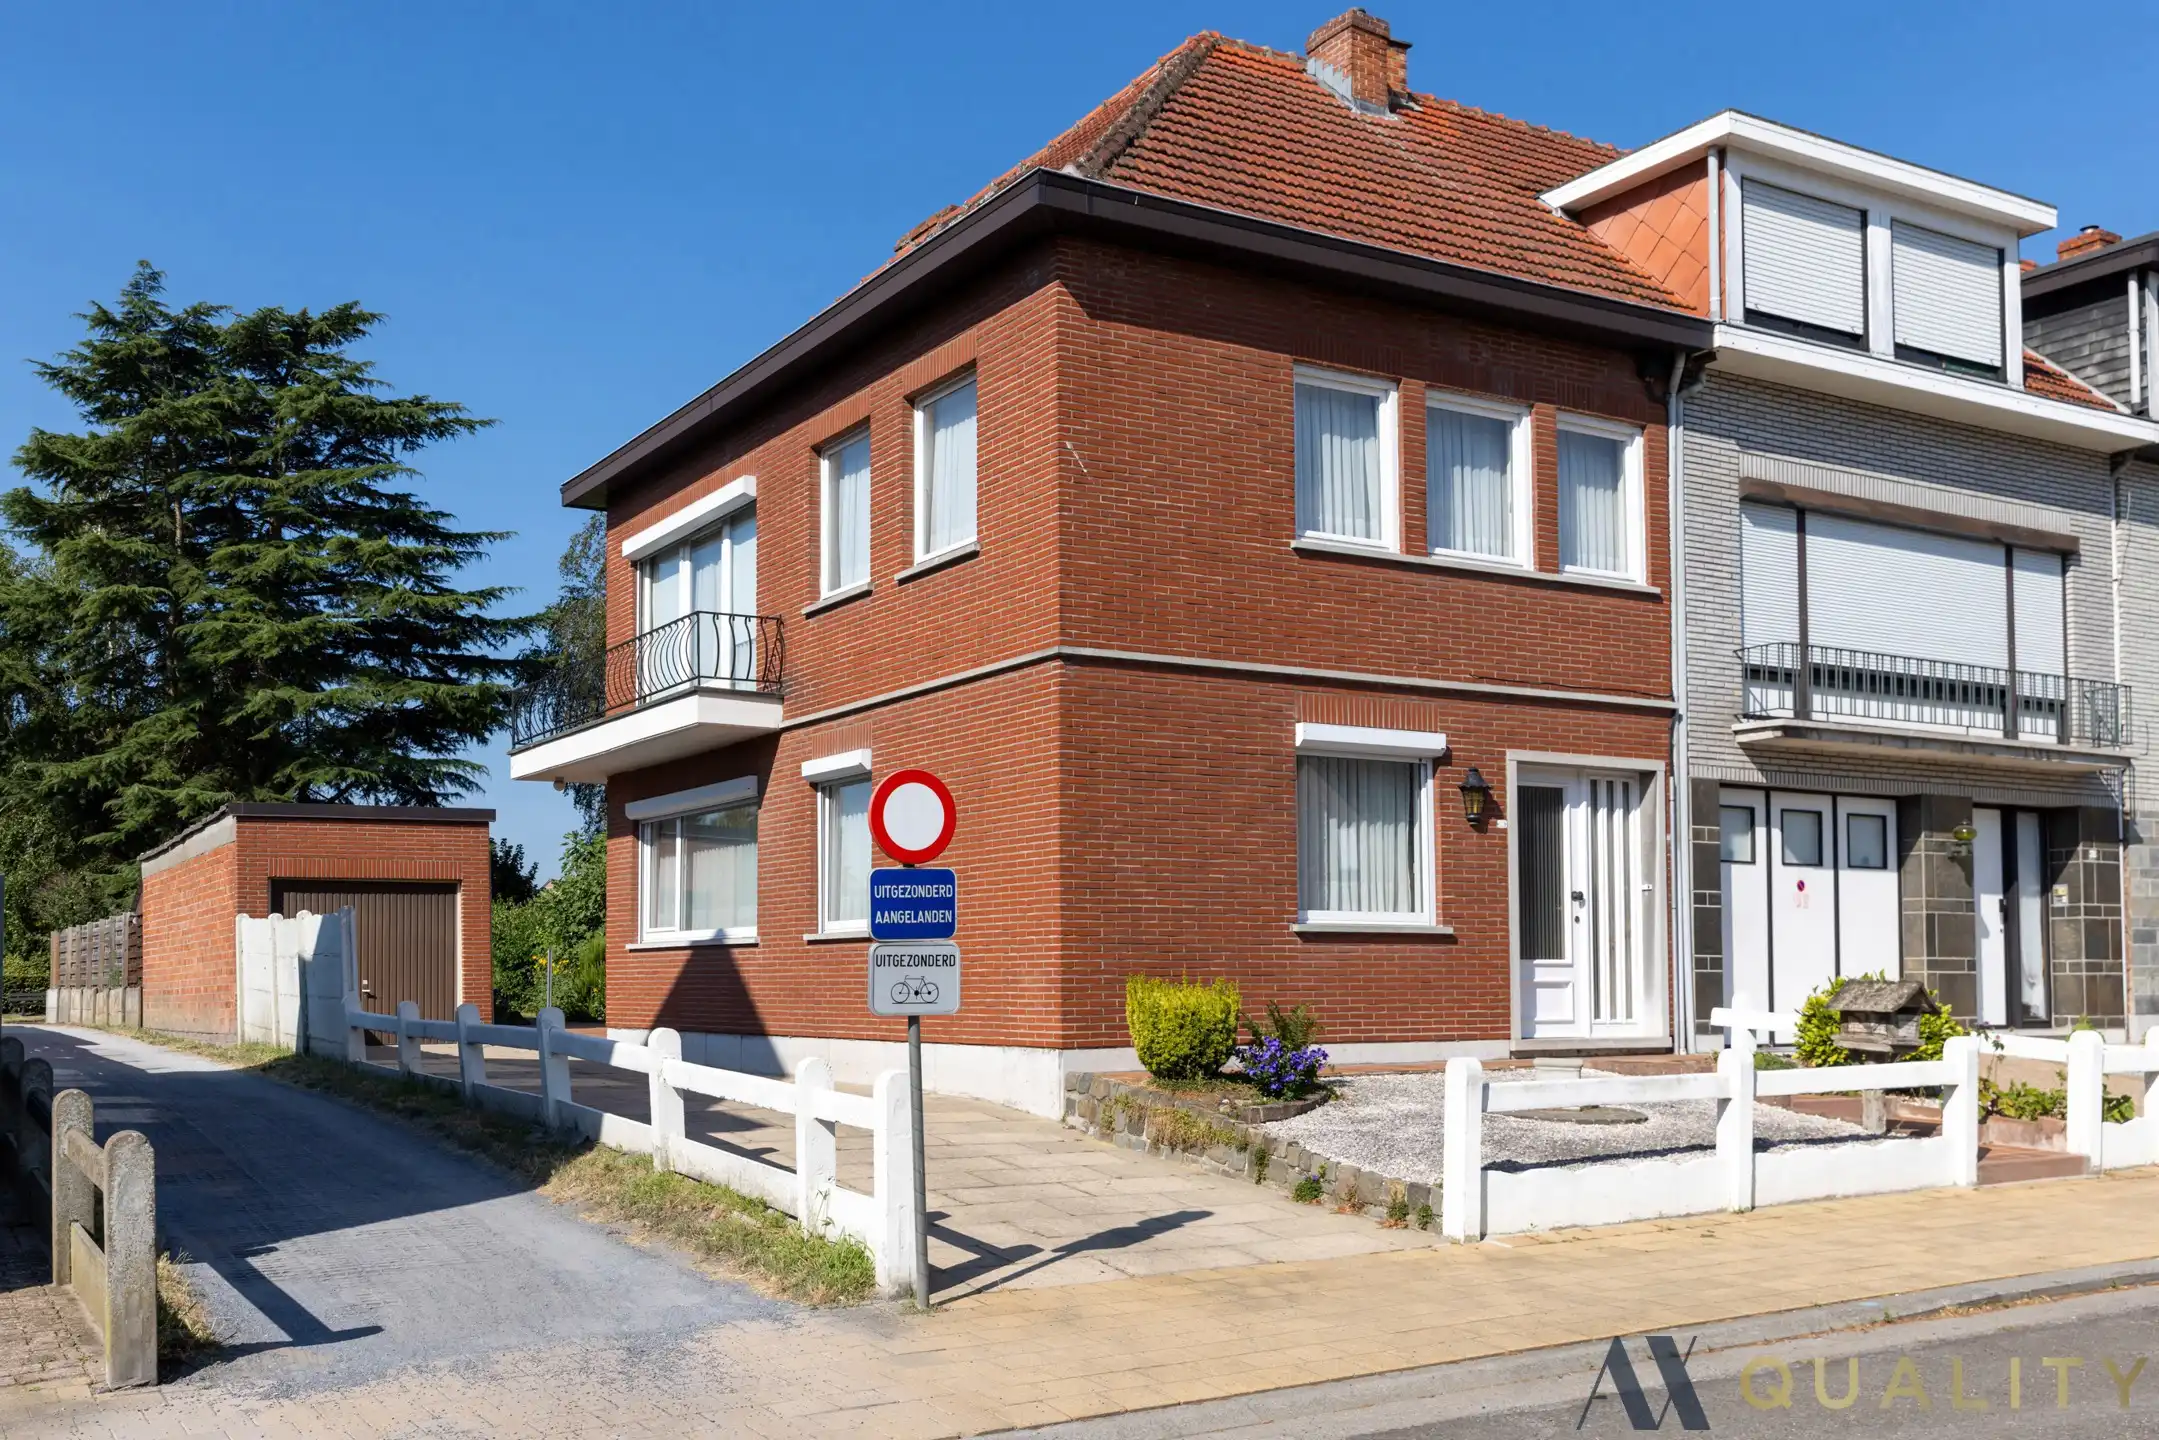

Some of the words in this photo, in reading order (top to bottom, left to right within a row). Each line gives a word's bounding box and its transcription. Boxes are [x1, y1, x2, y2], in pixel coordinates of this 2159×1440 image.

[874, 884, 953, 898] UITGEZONDERD
[875, 910, 952, 924] AANGELANDEN
[875, 954, 956, 967] UITGEZONDERD
